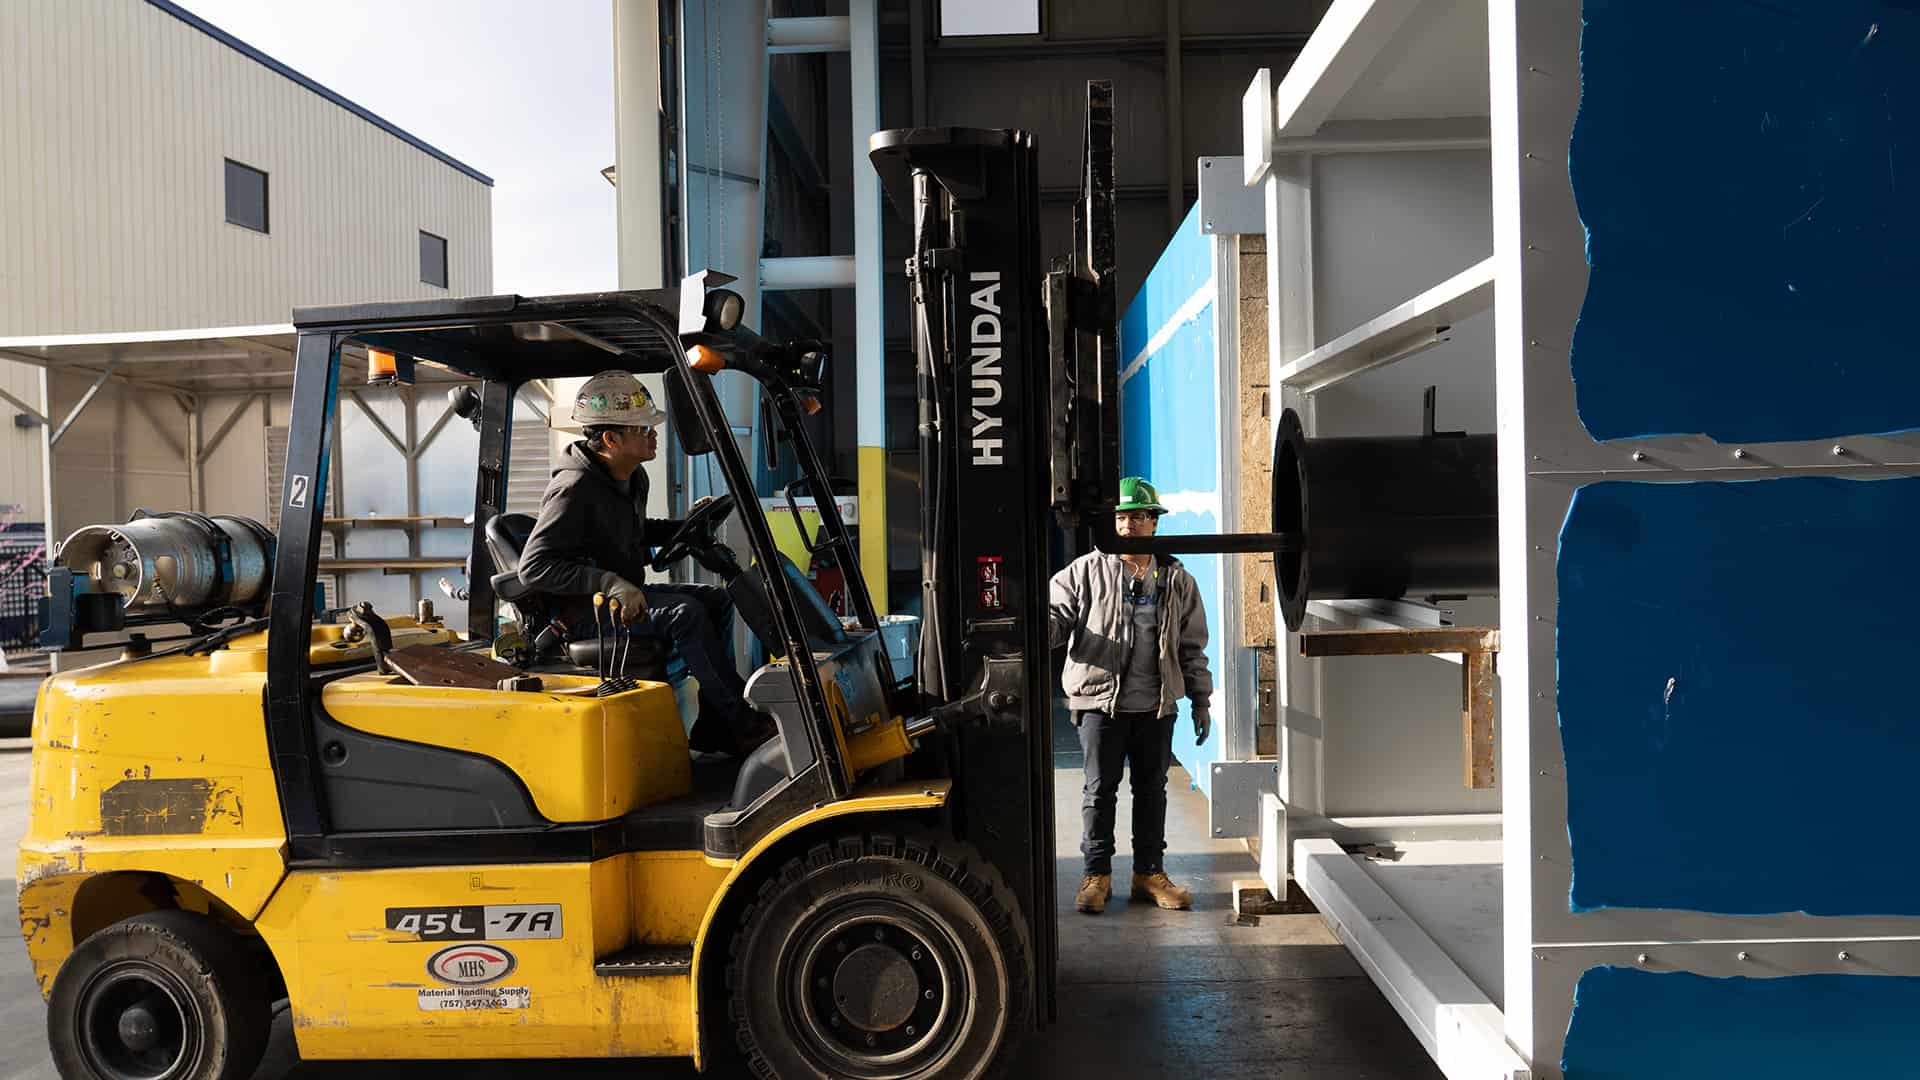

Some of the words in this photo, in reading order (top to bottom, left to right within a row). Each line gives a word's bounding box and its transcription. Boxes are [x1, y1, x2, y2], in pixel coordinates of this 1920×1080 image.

[970, 271, 1003, 466] HYUNDAI
[291, 477, 306, 505] 2
[458, 960, 486, 978] MHS
[418, 988, 455, 997] Material
[457, 987, 497, 998] Handling
[499, 986, 529, 997] Supply
[440, 1000, 463, 1009] (757)
